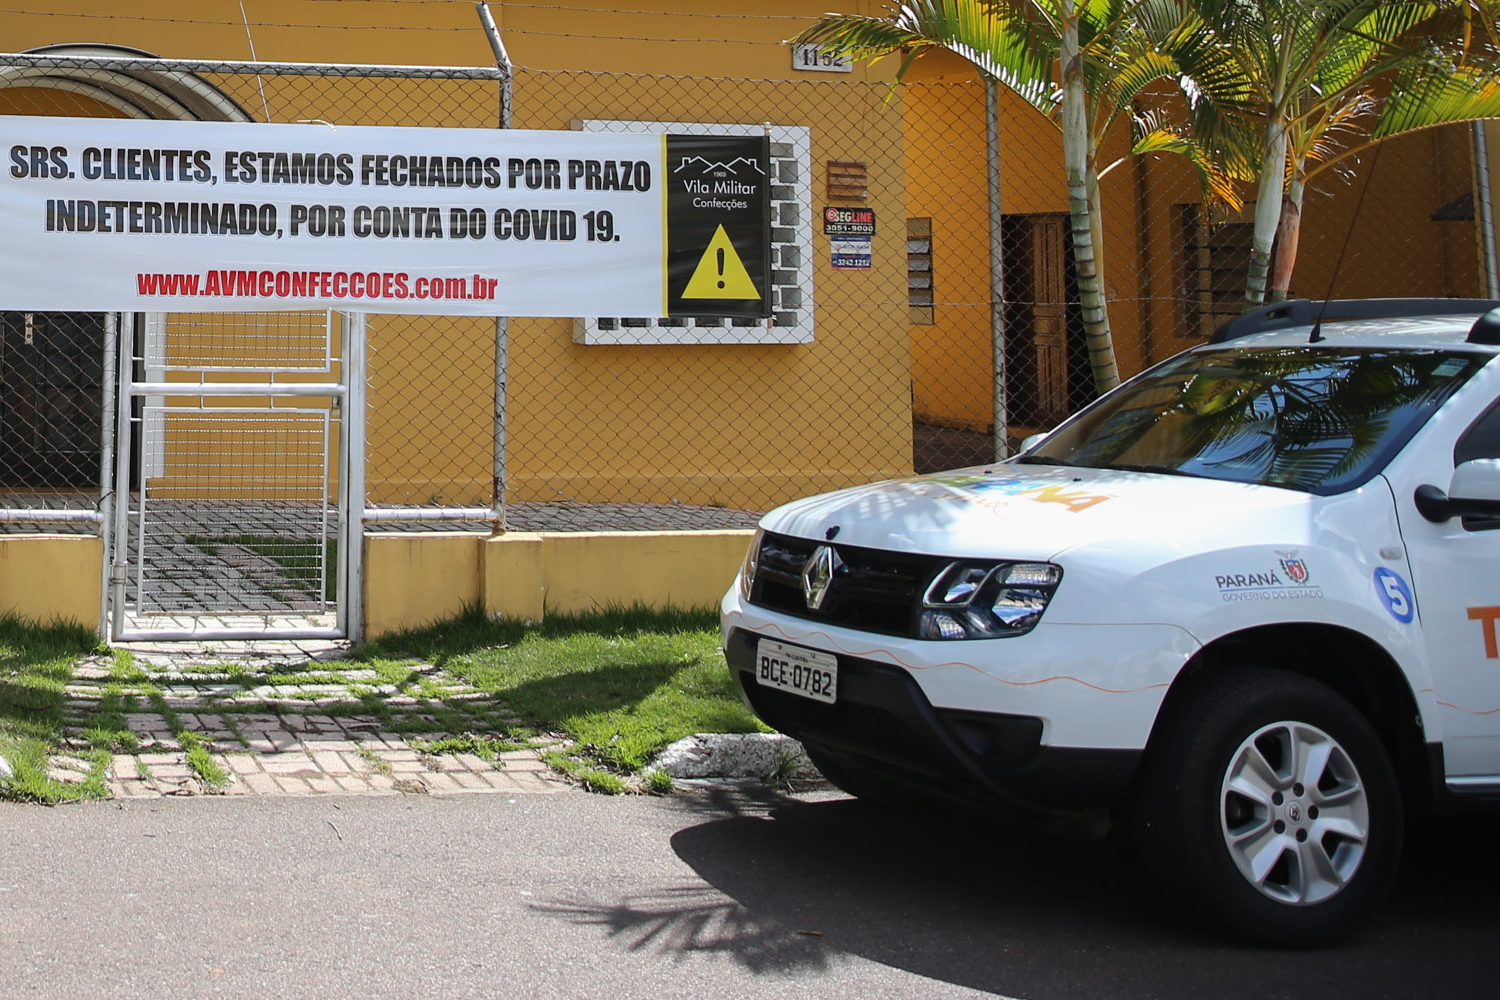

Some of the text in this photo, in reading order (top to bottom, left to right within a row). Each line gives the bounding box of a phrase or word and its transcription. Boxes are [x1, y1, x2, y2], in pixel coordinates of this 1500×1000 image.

[10, 145, 652, 192] SRS. CLIENTES, ESTAMOS FECHADOS POR PRAZO
[683, 179, 757, 195] Vila Militar
[693, 197, 748, 211] Confecções
[45, 199, 621, 243] INDETERMINADO, POR CONTA DO COVID 19.
[835, 211, 873, 223] SEGLINE
[136, 269, 499, 302] www.AVMCONFECCOES.com.br
[1214, 569, 1283, 589] PARANÁ
[1221, 588, 1324, 602] GOVERNO DO ESTADO
[1379, 574, 1410, 617] 5
